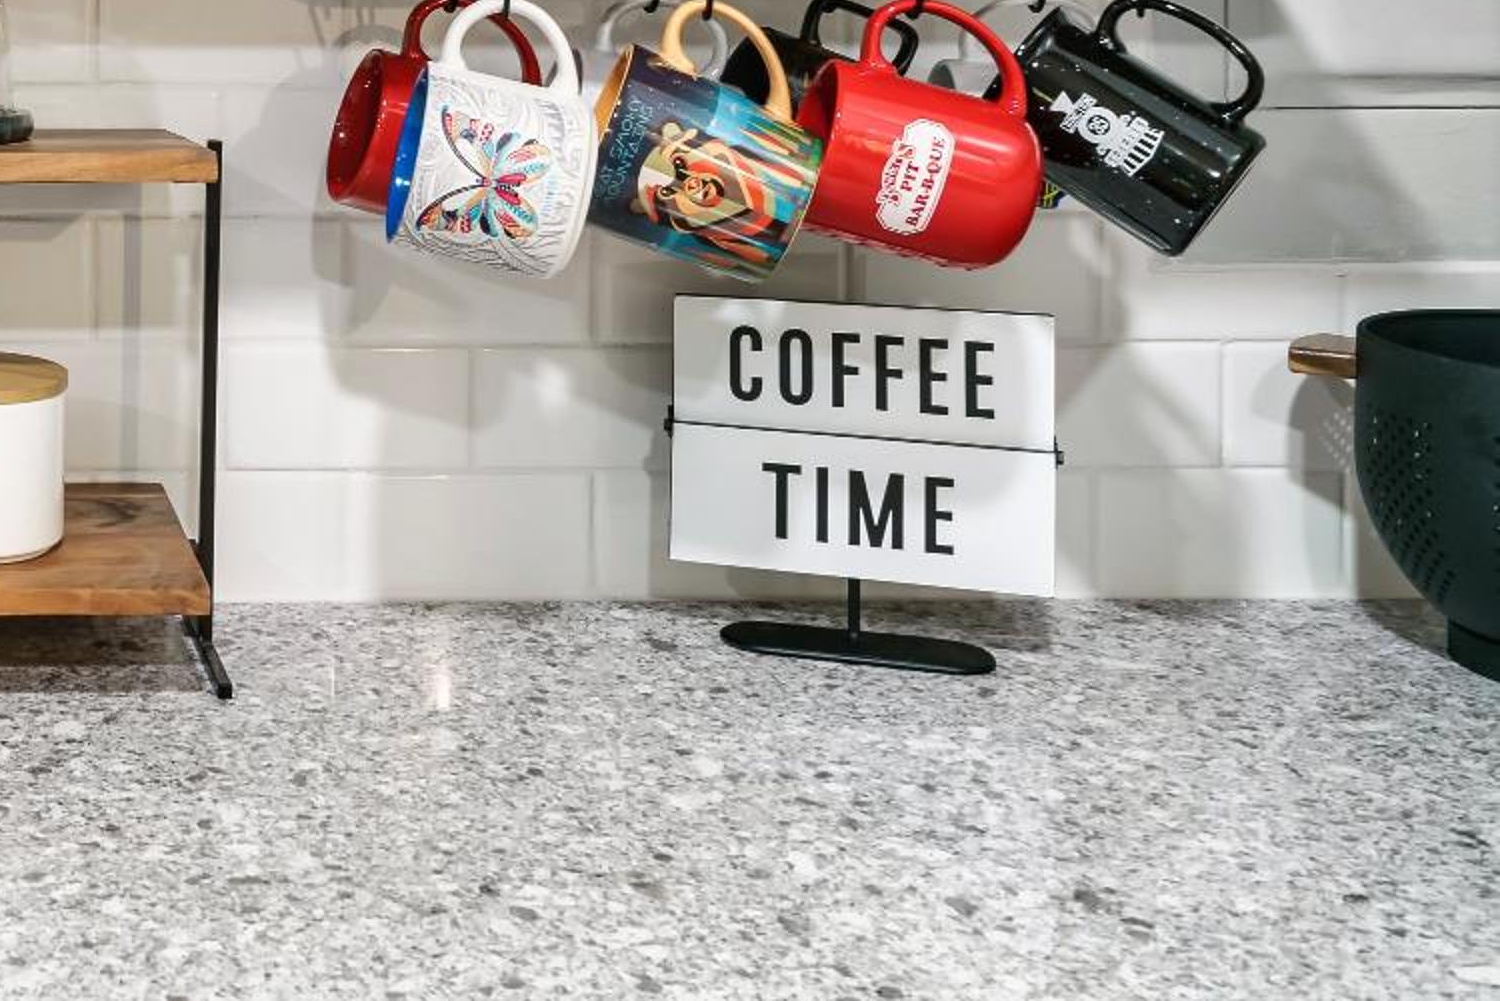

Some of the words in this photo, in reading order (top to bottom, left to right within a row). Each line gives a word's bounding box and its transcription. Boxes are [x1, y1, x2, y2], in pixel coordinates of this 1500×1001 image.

[899, 160, 920, 193] PIT
[905, 136, 946, 228] BAR-B-QUE
[729, 324, 995, 420] COFFEE
[761, 462, 955, 556] TIME
